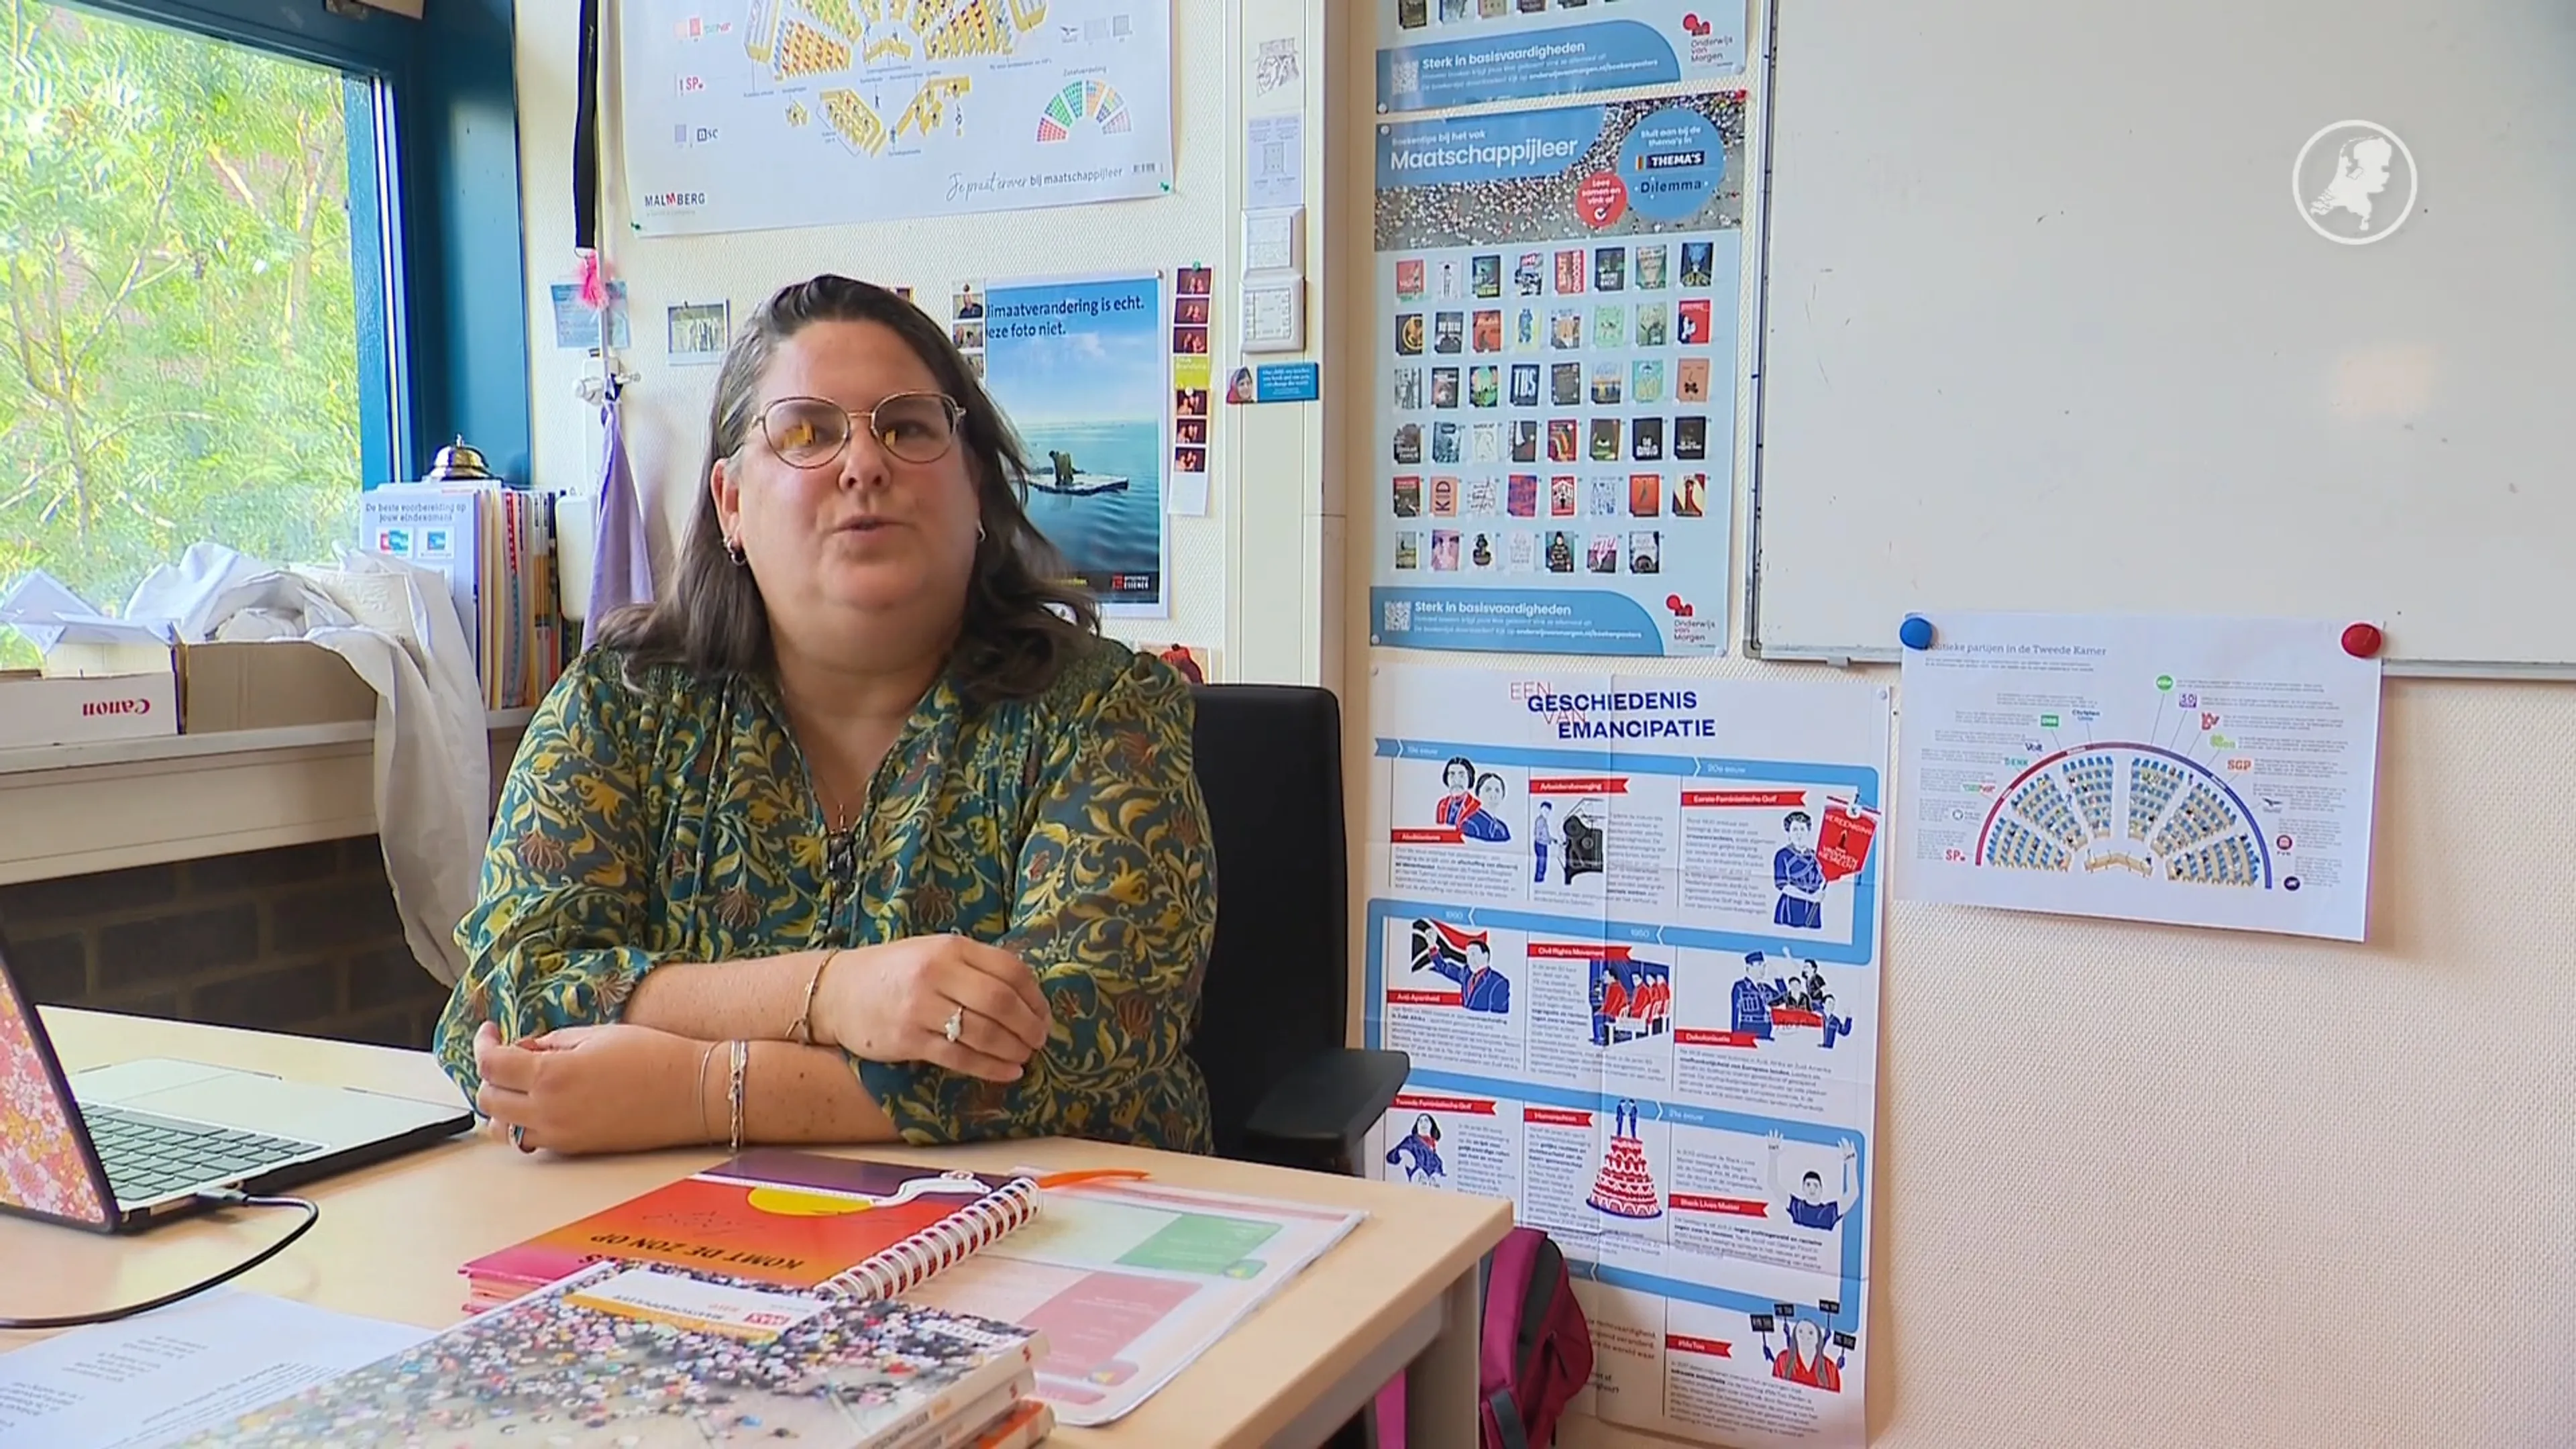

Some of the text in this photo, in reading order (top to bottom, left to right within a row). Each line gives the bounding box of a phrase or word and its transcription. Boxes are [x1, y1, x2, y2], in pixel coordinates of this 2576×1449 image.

[1690, 36, 1733, 47] Onderwijs
[1423, 55, 1452, 69] Sterk
[1455, 54, 1466, 66] in
[1469, 42, 1585, 65] basisvaardigheden
[1690, 52, 1723, 63] Morgen
[1438, 133, 1450, 145] bij
[1452, 131, 1468, 141] het
[1469, 129, 1487, 140] vak
[1690, 125, 1701, 134] de
[1391, 138, 1578, 170] Maatschappijleer
[1652, 153, 1702, 166] THEMA'S
[1030, 175, 1042, 187] bij
[1044, 168, 1122, 185] maatschappijleer
[1592, 179, 1611, 188] Lees
[1641, 180, 1701, 194] Dilemma
[645, 193, 706, 207] MALMBERG
[987, 295, 1144, 318] limaatverandering is echt.
[986, 321, 1066, 339] eze foto niet.
[1435, 480, 1451, 512] KID
[1415, 601, 1572, 617] Sterk in basisvaardigheden
[1674, 619, 1715, 631] Onderwijs
[1674, 633, 1705, 643] Morgen
[1966, 645, 2004, 655] partijen
[2006, 645, 2016, 653] in
[2018, 645, 2031, 653] de
[2033, 645, 2071, 655] Tweede
[2073, 645, 2107, 656] Kamer
[1510, 682, 1552, 700] EEN
[83, 698, 150, 717] Canon
[1528, 691, 1697, 712] GESCHIEDENIS
[1558, 719, 1716, 739] EMANCIPATIE
[2227, 759, 2251, 770] SGP
[590, 1233, 805, 1270] KOMT DE ZON OP
